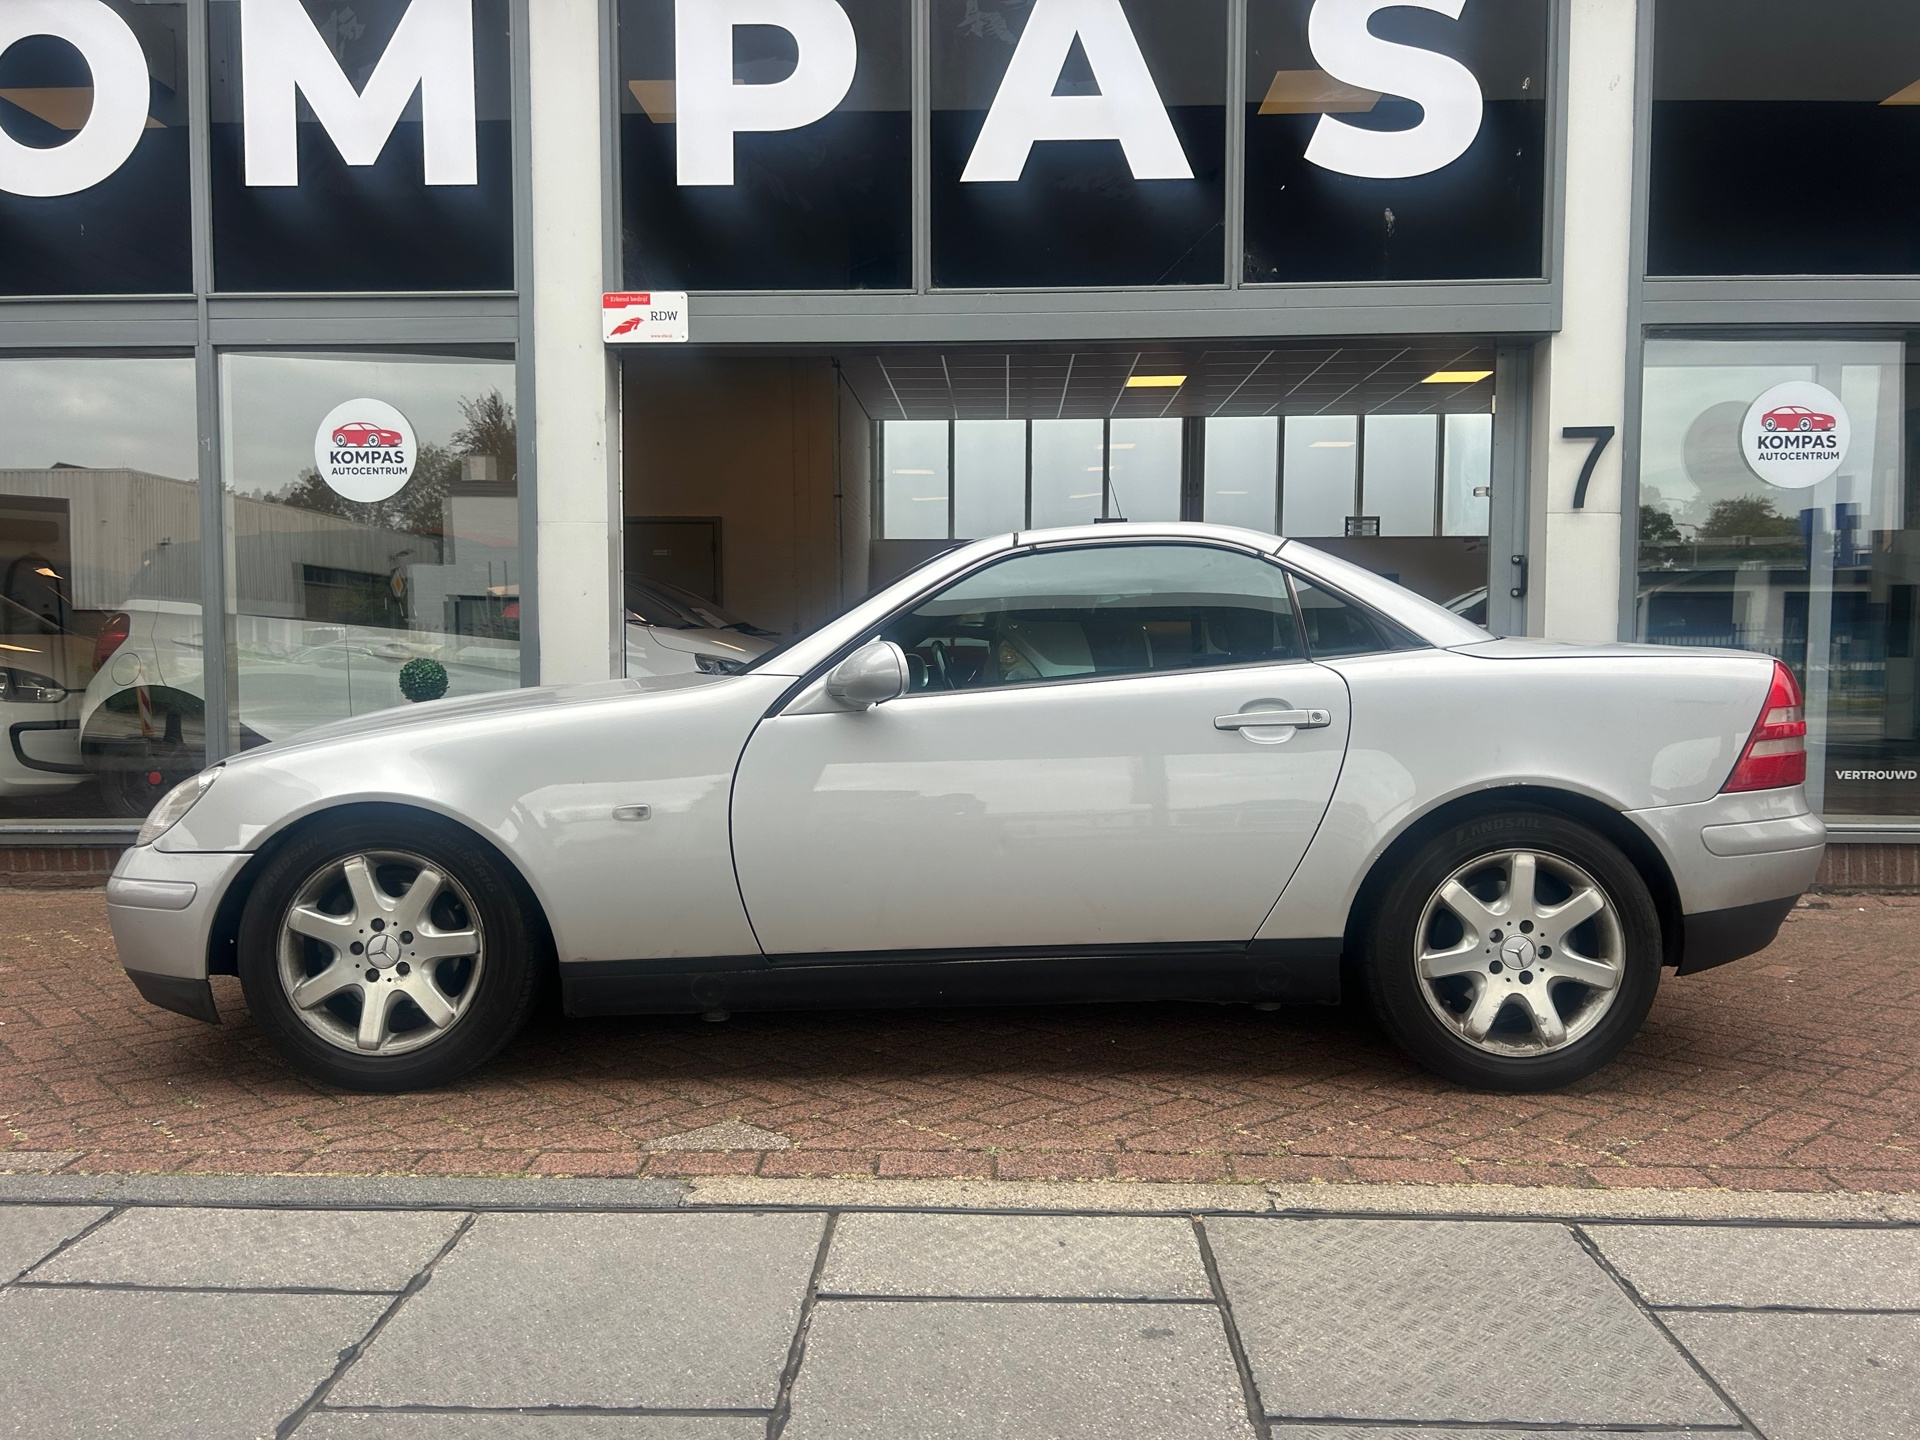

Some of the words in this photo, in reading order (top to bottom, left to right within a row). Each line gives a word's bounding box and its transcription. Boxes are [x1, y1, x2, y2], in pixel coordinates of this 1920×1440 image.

[650, 311, 678, 321] RDW
[1757, 435, 1837, 449] KOMPAS
[329, 451, 405, 464] KOMPAS
[1758, 452, 1840, 461] AUTOCENTRUM
[331, 467, 408, 475] AUTOCENTRUM
[1563, 426, 1615, 508] 7
[1835, 770, 1918, 780] VERTROUWD
[1456, 817, 1543, 847] LANDSAIL
